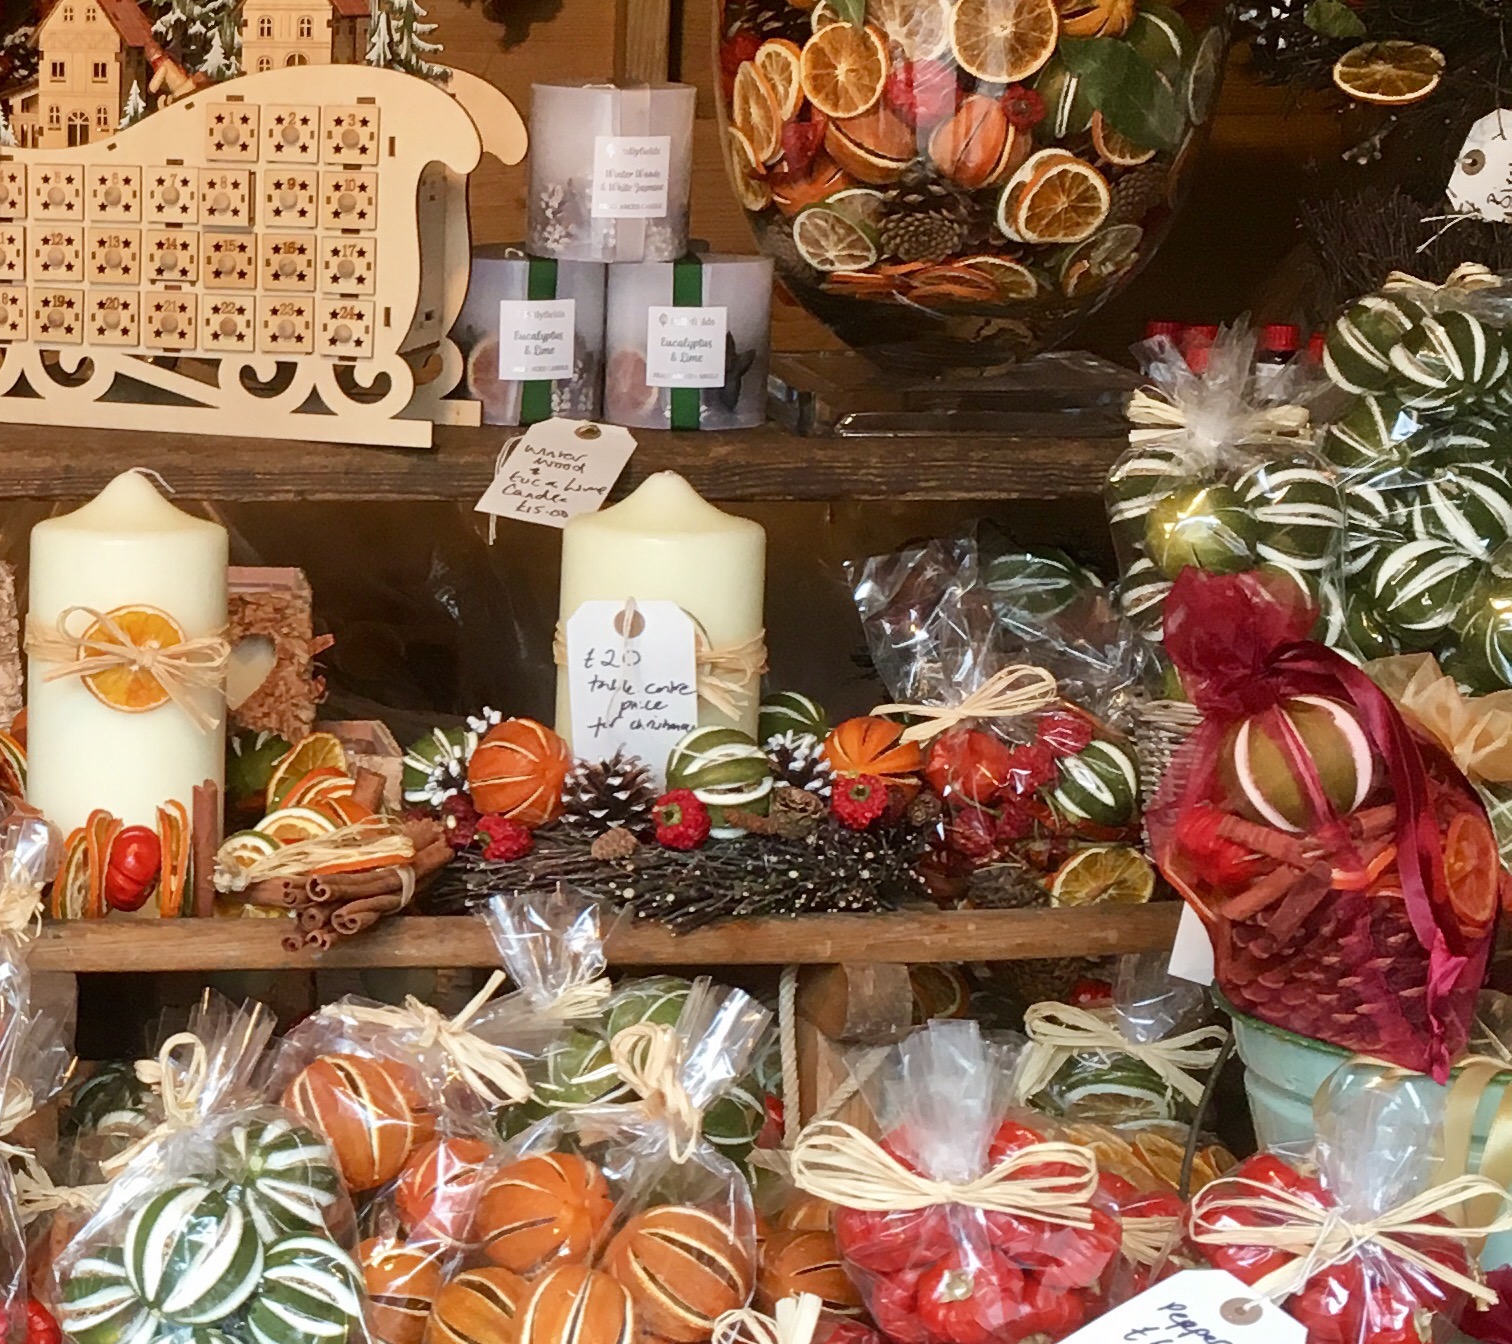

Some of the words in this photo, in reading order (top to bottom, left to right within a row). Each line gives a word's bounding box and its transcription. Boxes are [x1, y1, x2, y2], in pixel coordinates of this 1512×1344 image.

[288, 112, 297, 125] 2
[347, 113, 356, 126] 3
[622, 146, 662, 157] ollyfields
[111, 173, 119, 185] 6
[170, 173, 178, 187] 7
[344, 178, 356, 191] 10
[51, 233, 63, 246] 12
[107, 235, 120, 248] 13
[165, 237, 178, 250] 14
[223, 240, 237, 252] 15
[283, 242, 296, 254] 16
[342, 244, 357, 257] 17
[52, 295, 65, 308] 19
[105, 297, 120, 311] 20
[163, 300, 177, 313] 21
[221, 301, 236, 314] 22
[279, 303, 295, 315] 23
[339, 306, 355, 319] 24
[661, 336, 713, 351] Eucalyptus
[680, 351, 704, 363] Lime
